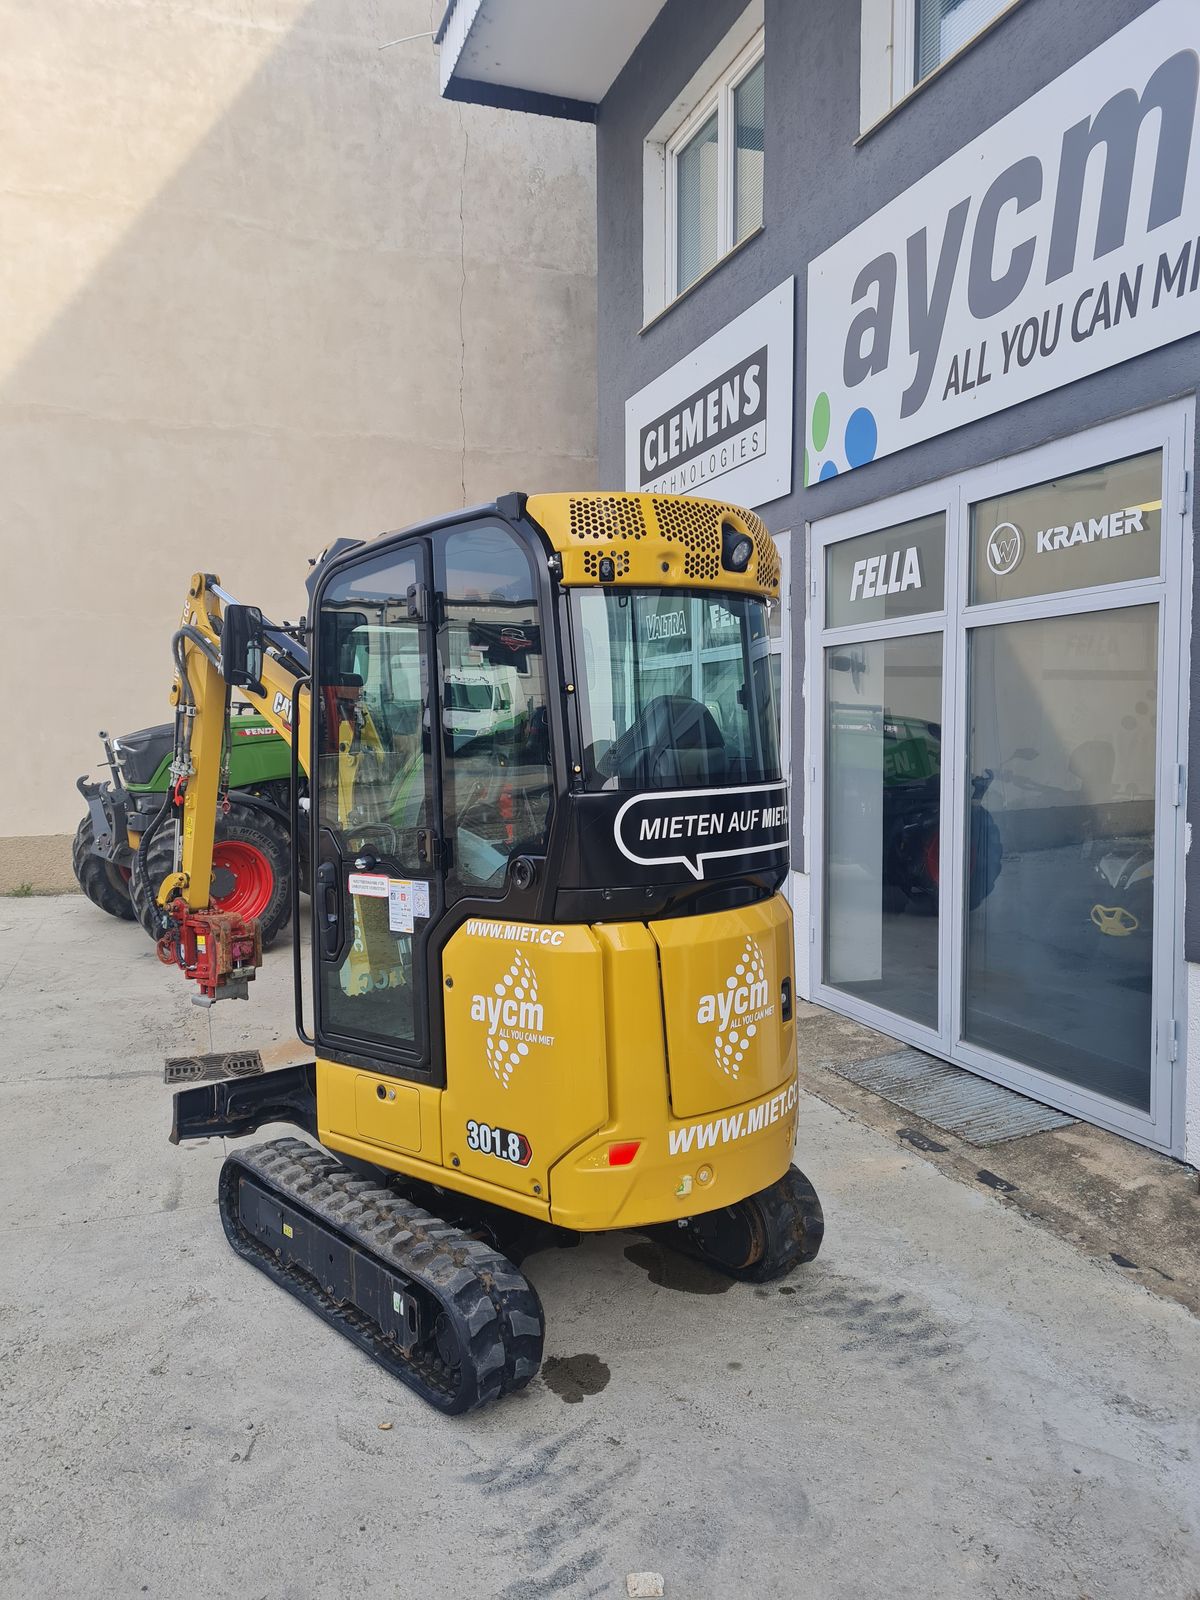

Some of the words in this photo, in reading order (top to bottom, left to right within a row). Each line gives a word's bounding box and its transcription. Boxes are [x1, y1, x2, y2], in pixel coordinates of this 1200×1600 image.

[843, 48, 1199, 418] aycm
[942, 340, 991, 401] ALL
[1001, 303, 1064, 375] YOU
[1070, 263, 1144, 343] CAN
[644, 364, 761, 472] CLEMENS
[645, 431, 759, 494] CHNOLOGIES
[1036, 508, 1145, 553] KRAMER
[850, 546, 922, 601] FELLA
[646, 610, 686, 641] VALTRA
[639, 813, 725, 841] MIETEN
[728, 809, 760, 832] AUF
[465, 920, 565, 946] WWW.MIET.CC
[470, 994, 544, 1035] aycm
[697, 979, 768, 1032] aycm
[730, 1017, 742, 1029] ALL
[742, 1013, 754, 1025] YOU
[754, 1009, 765, 1021] CAN
[764, 1004, 775, 1017] MIET
[499, 1027, 511, 1039] ALL
[511, 1030, 524, 1042] YOU
[525, 1032, 538, 1044] CAN
[538, 1035, 555, 1047] MIET
[466, 1119, 521, 1162] 301.8
